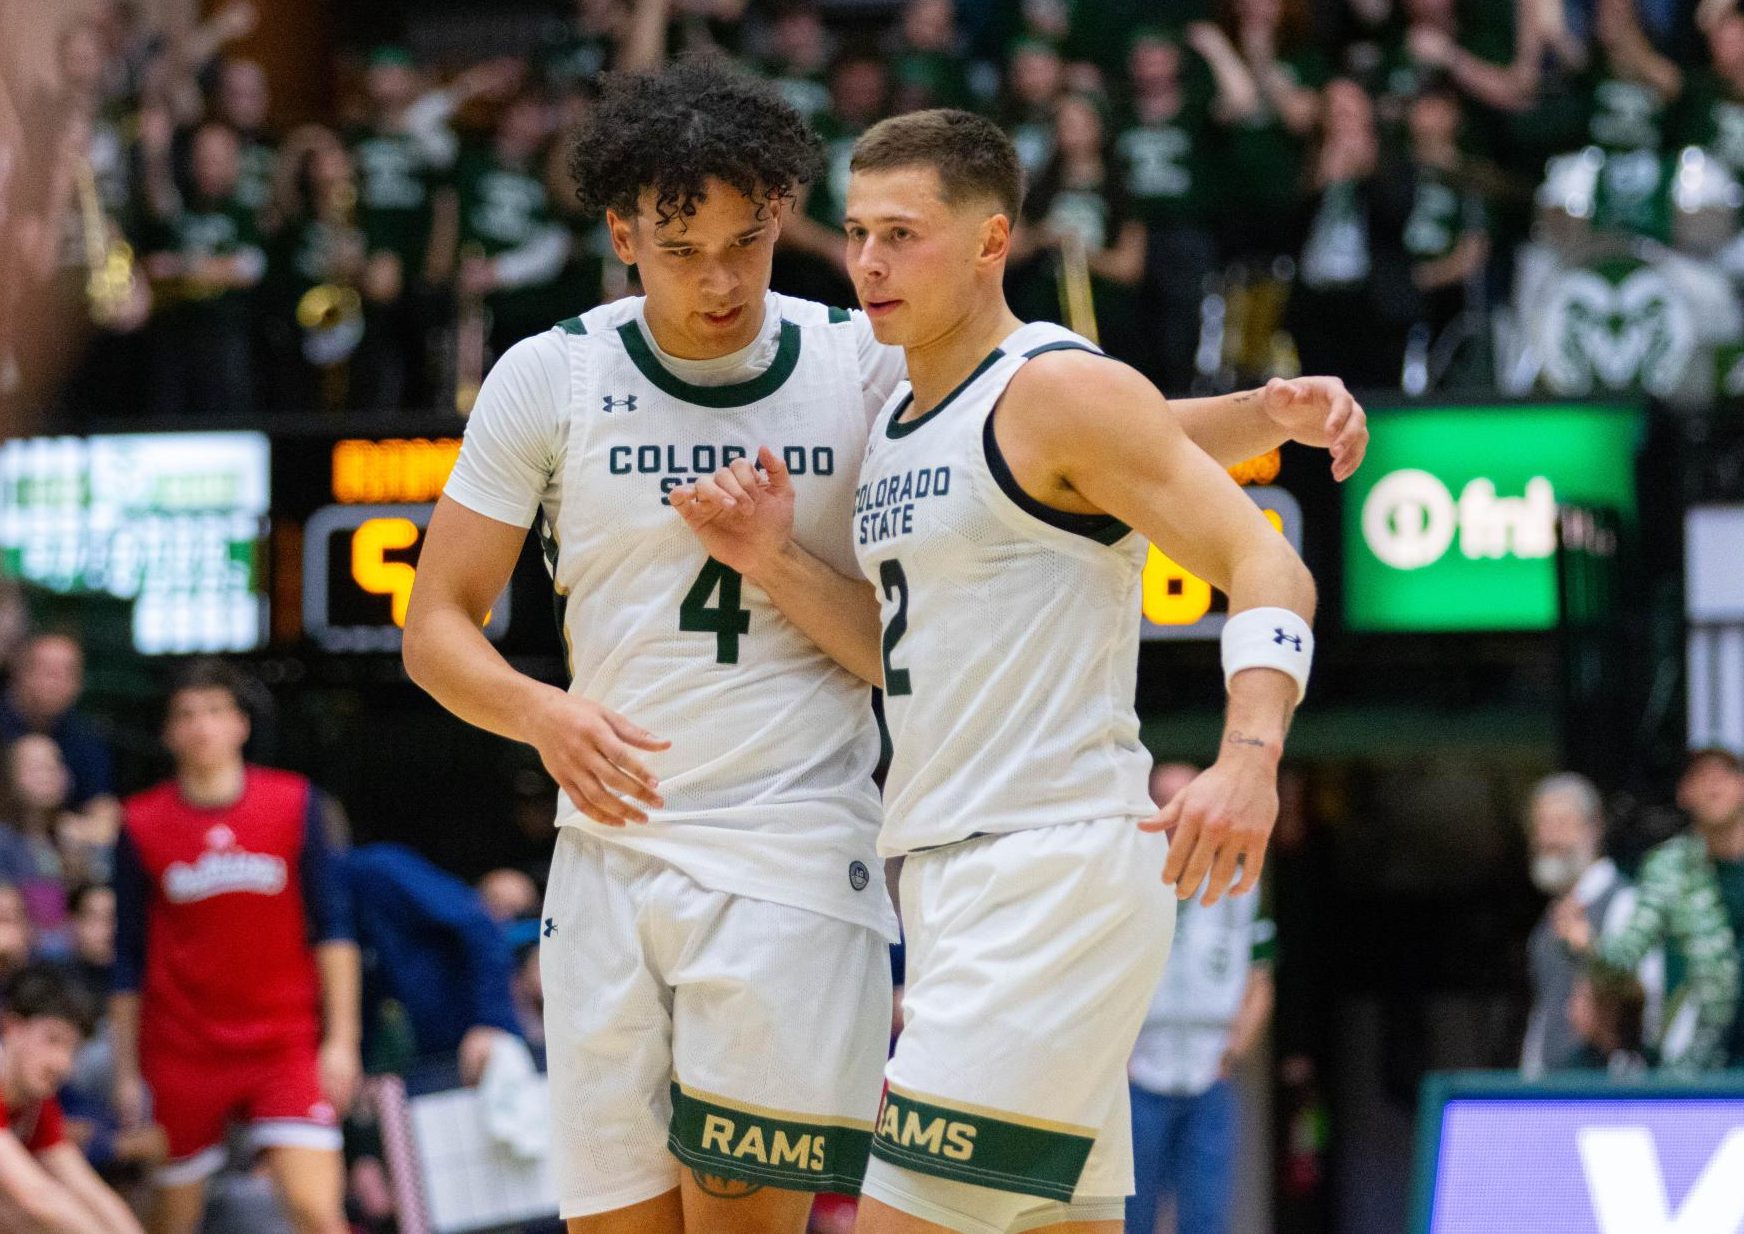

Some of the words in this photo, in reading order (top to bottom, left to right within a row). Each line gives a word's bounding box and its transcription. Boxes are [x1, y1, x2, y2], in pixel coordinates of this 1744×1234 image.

[609, 444, 835, 476] COLORDO
[860, 504, 914, 545] STATE
[679, 555, 751, 665] 4
[879, 558, 913, 697] 2
[701, 1113, 825, 1171] RAMS
[880, 1104, 977, 1161] AMS
